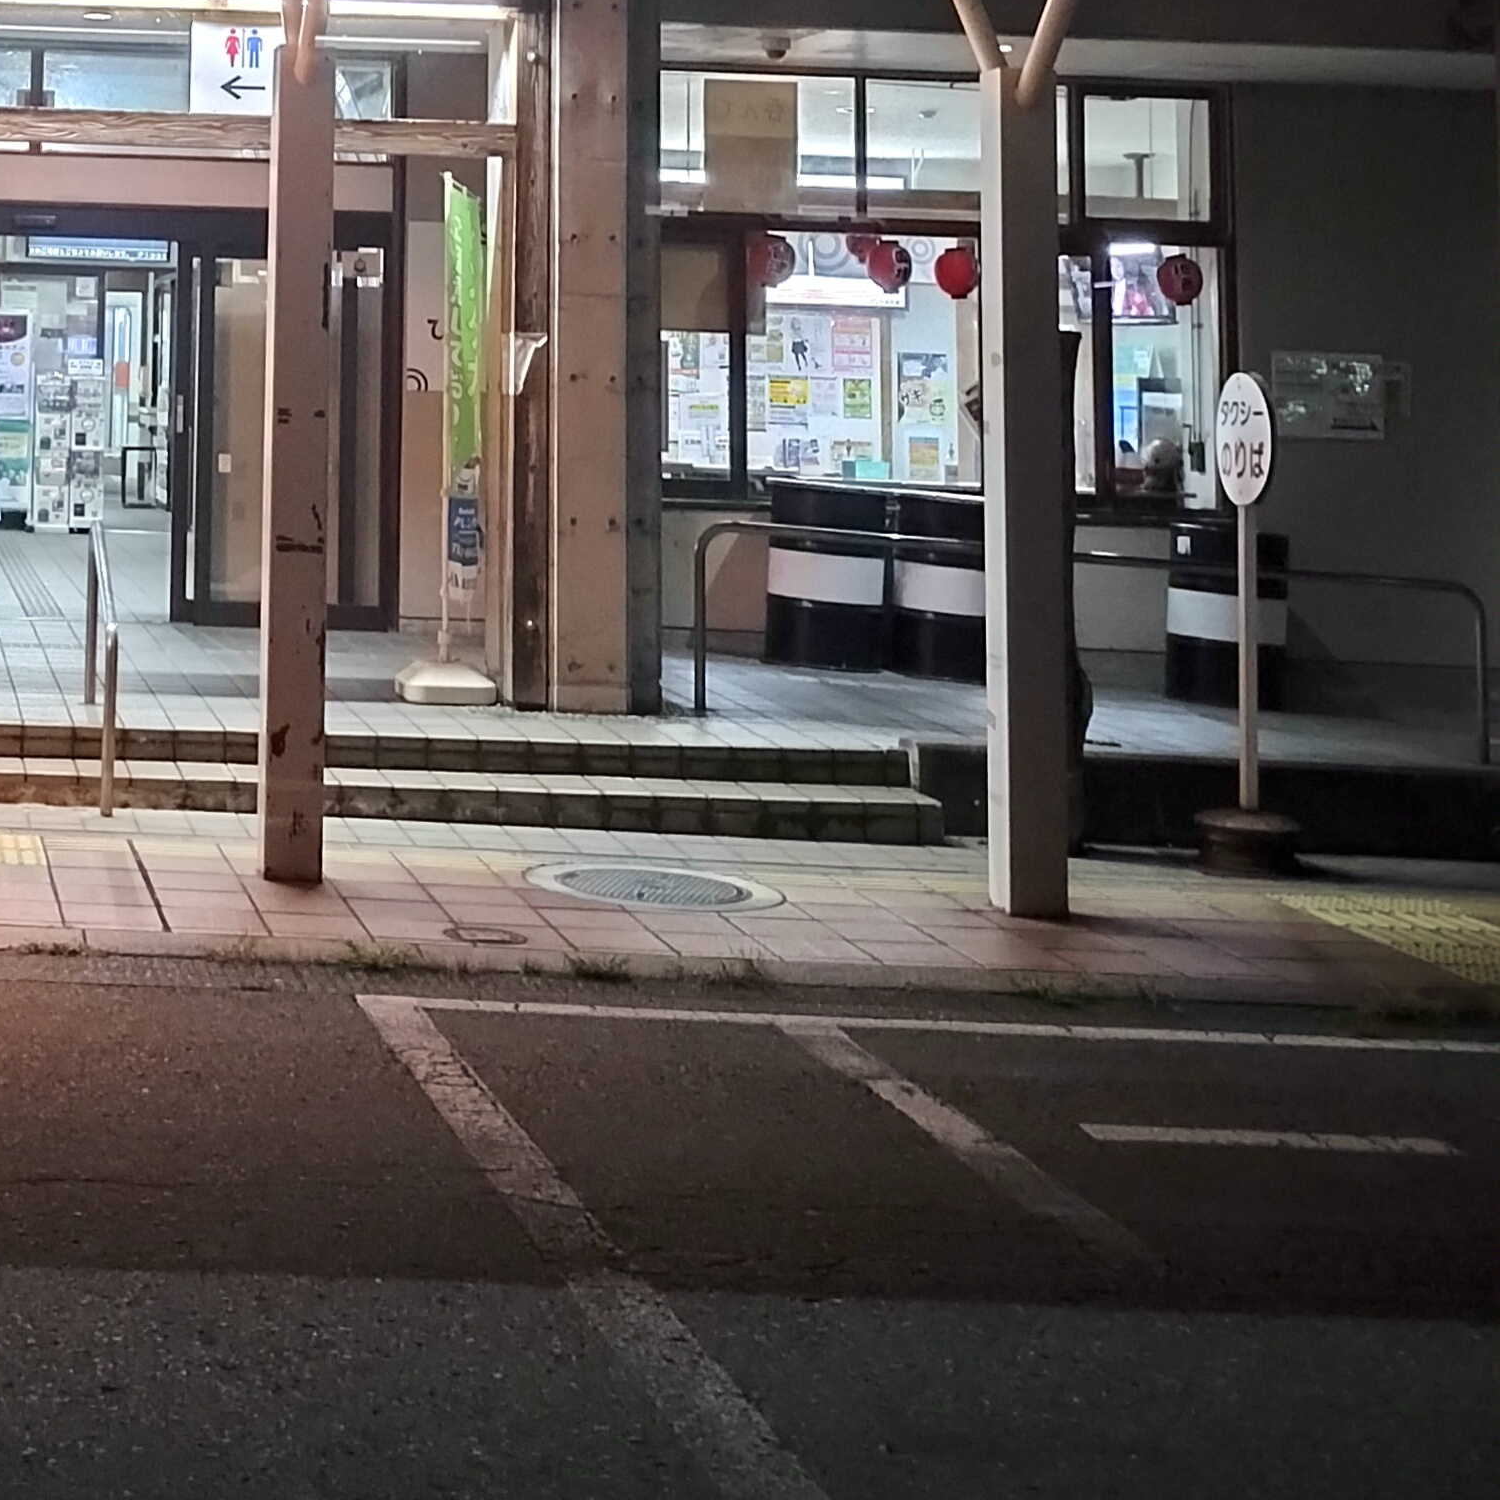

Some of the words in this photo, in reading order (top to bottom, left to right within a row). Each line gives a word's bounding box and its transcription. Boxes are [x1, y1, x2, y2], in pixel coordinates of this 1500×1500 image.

[1220, 400, 1264, 426] タクシー
[1220, 438, 1265, 479] のりば
